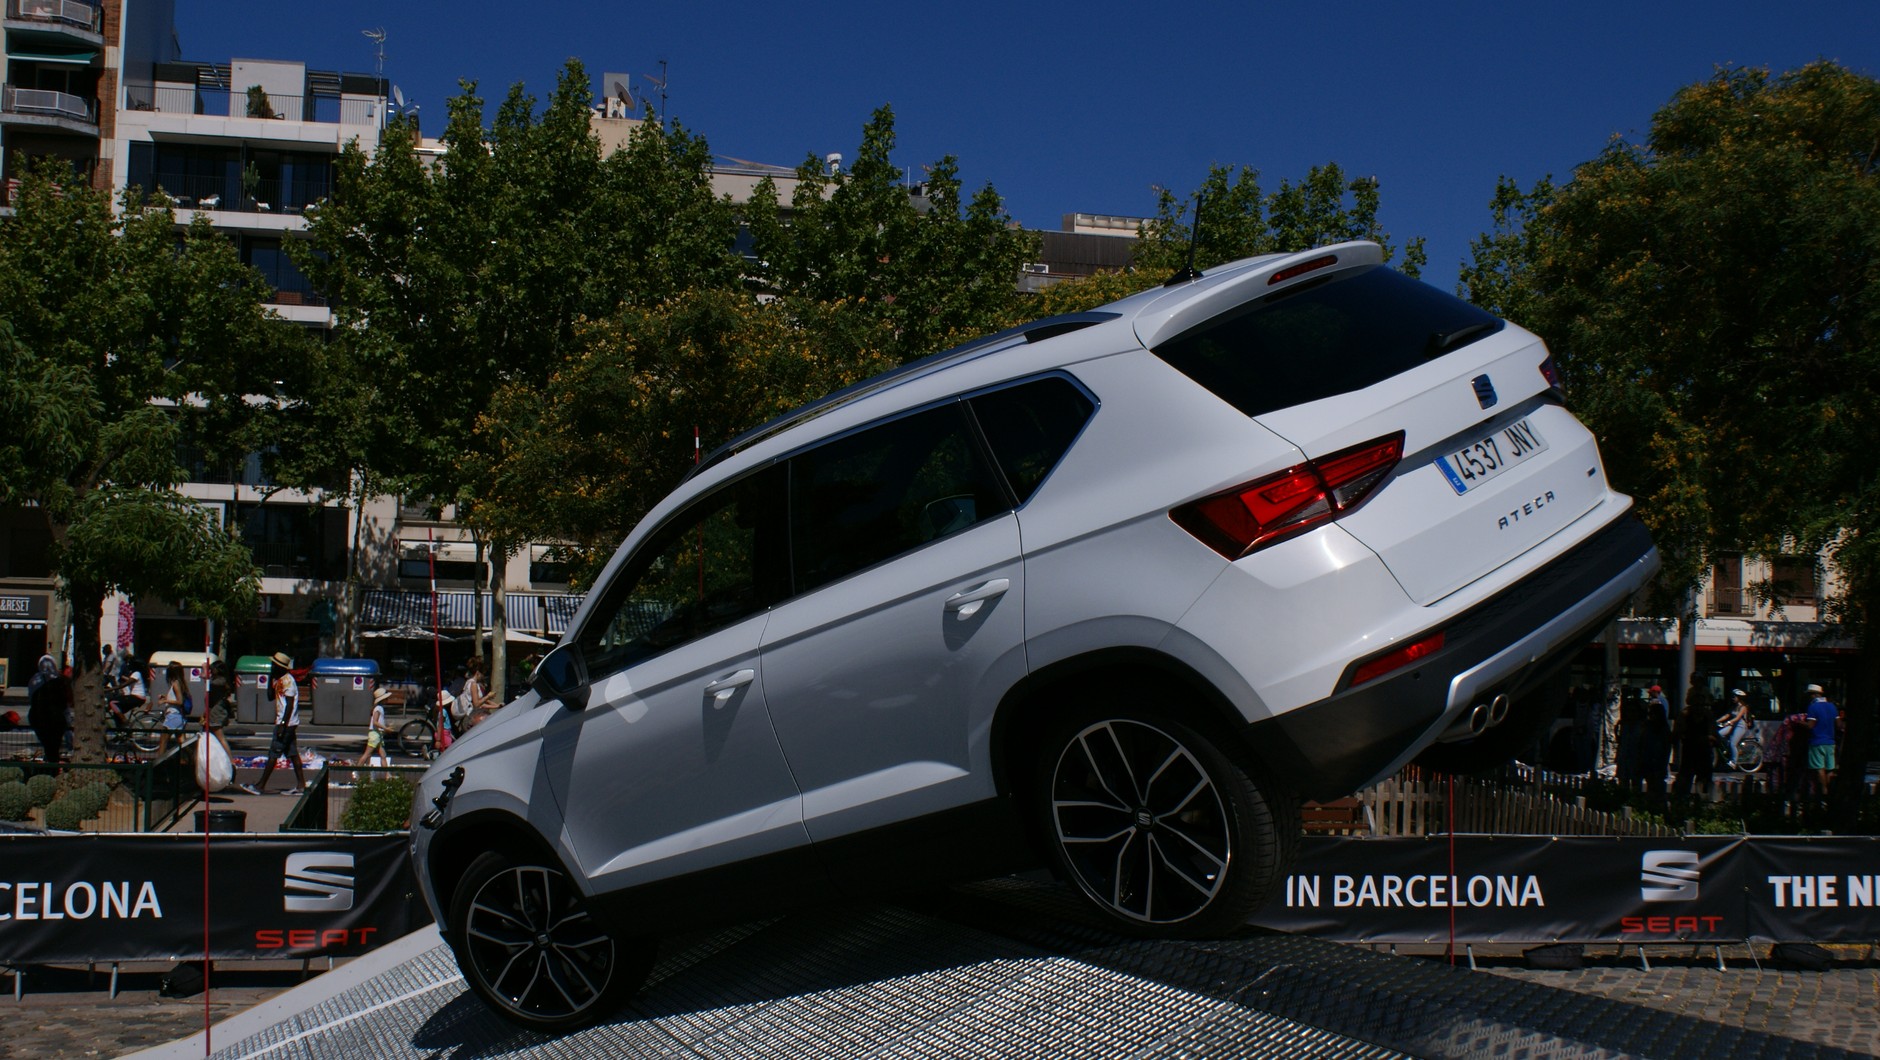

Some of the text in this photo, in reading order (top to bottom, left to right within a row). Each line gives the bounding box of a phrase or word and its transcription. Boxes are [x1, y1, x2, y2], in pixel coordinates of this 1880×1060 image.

[1454, 420, 1540, 480] 4537 JNY
[1498, 490, 1555, 530] ATECA
[0, 599, 30, 611] &RESET
[1286, 875, 1545, 907] IN BARCELONA
[1768, 875, 1839, 907] THE
[255, 927, 378, 949] SEAT
[1621, 916, 1724, 933] SEAT
